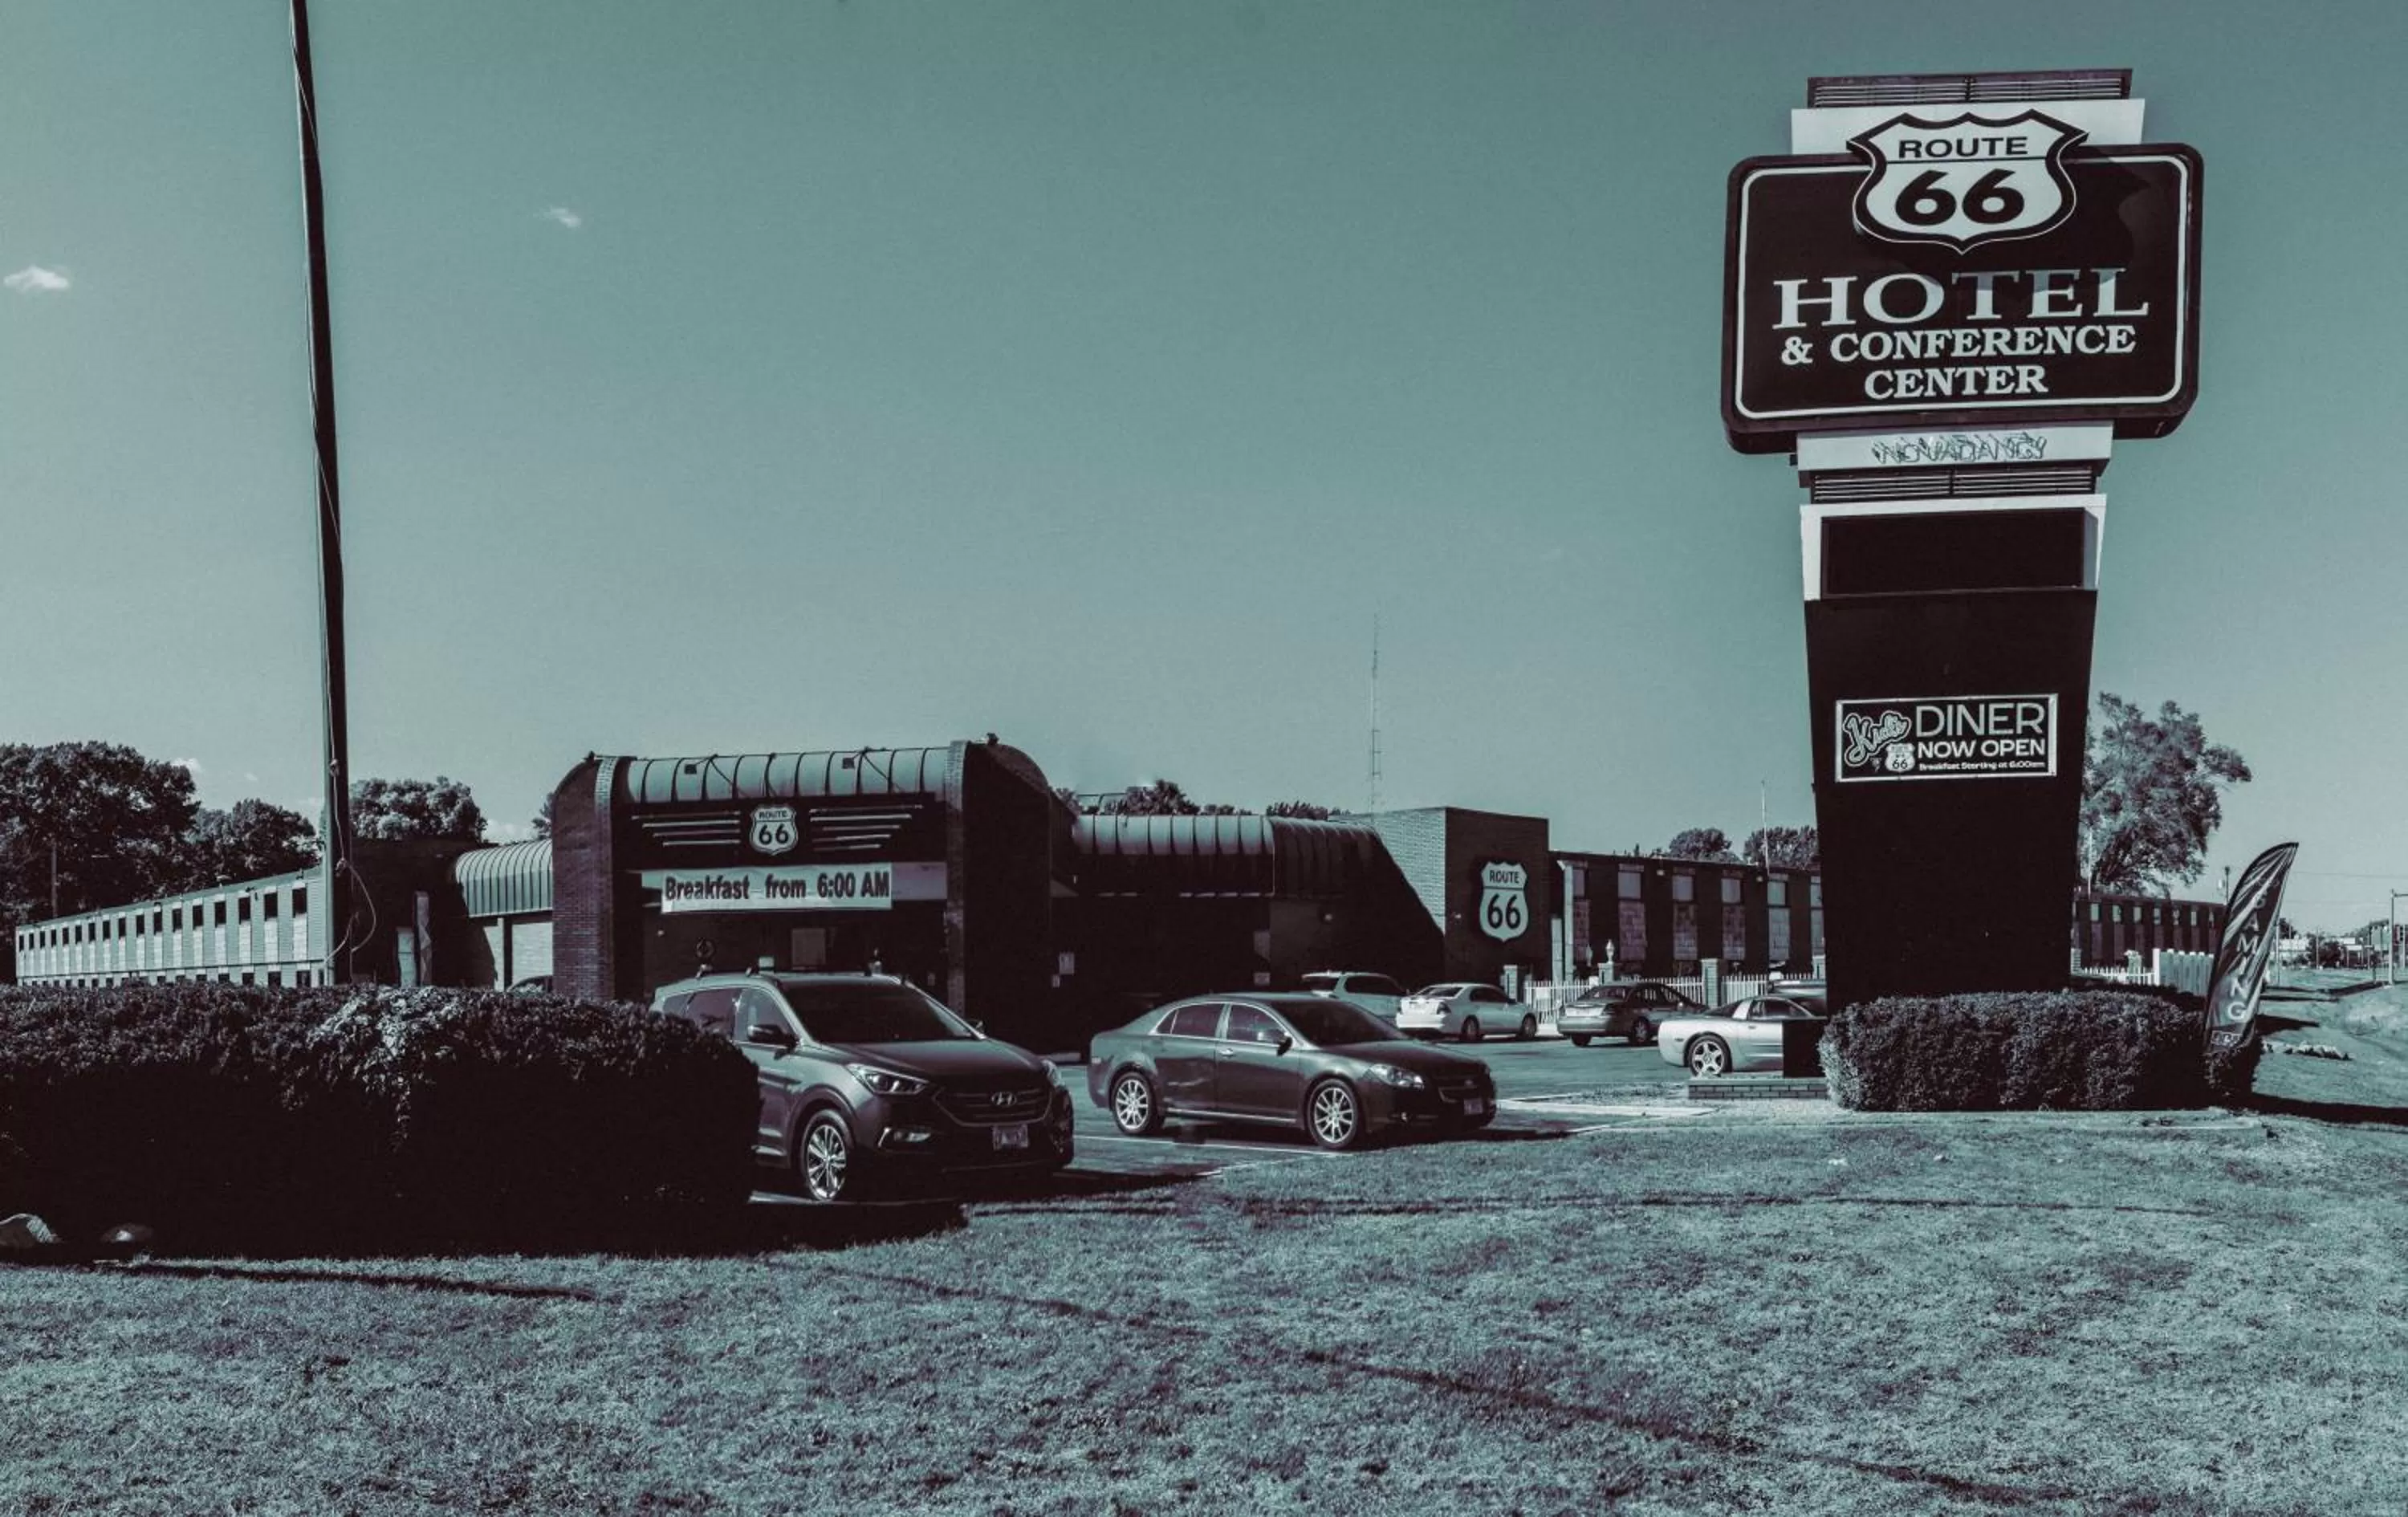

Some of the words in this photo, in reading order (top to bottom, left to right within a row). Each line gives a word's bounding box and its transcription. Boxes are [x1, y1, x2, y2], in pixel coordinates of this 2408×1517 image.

[1898, 136, 2028, 158] ROUTE
[1895, 168, 2025, 226] 66
[1771, 267, 2150, 330] HOTEL
[1780, 336, 1813, 366] &
[1830, 324, 2138, 364] CONFERENCE
[1864, 364, 2049, 401] CENTER
[1916, 702, 2046, 738] DINER
[1918, 739, 1976, 758] NOW
[1980, 738, 2046, 756] OPEN
[1892, 759, 1908, 770] 66
[1919, 762, 1960, 771] Breakfast
[759, 810, 787, 820] ROUTE
[759, 824, 790, 846] 66
[665, 875, 750, 901] Breakfast
[765, 873, 807, 899] from
[817, 872, 855, 898] 6:00
[860, 871, 890, 897] AM
[1489, 869, 1520, 885] ROUTE
[1487, 893, 1521, 930] 66
[2227, 890, 2268, 1020] GAMING
